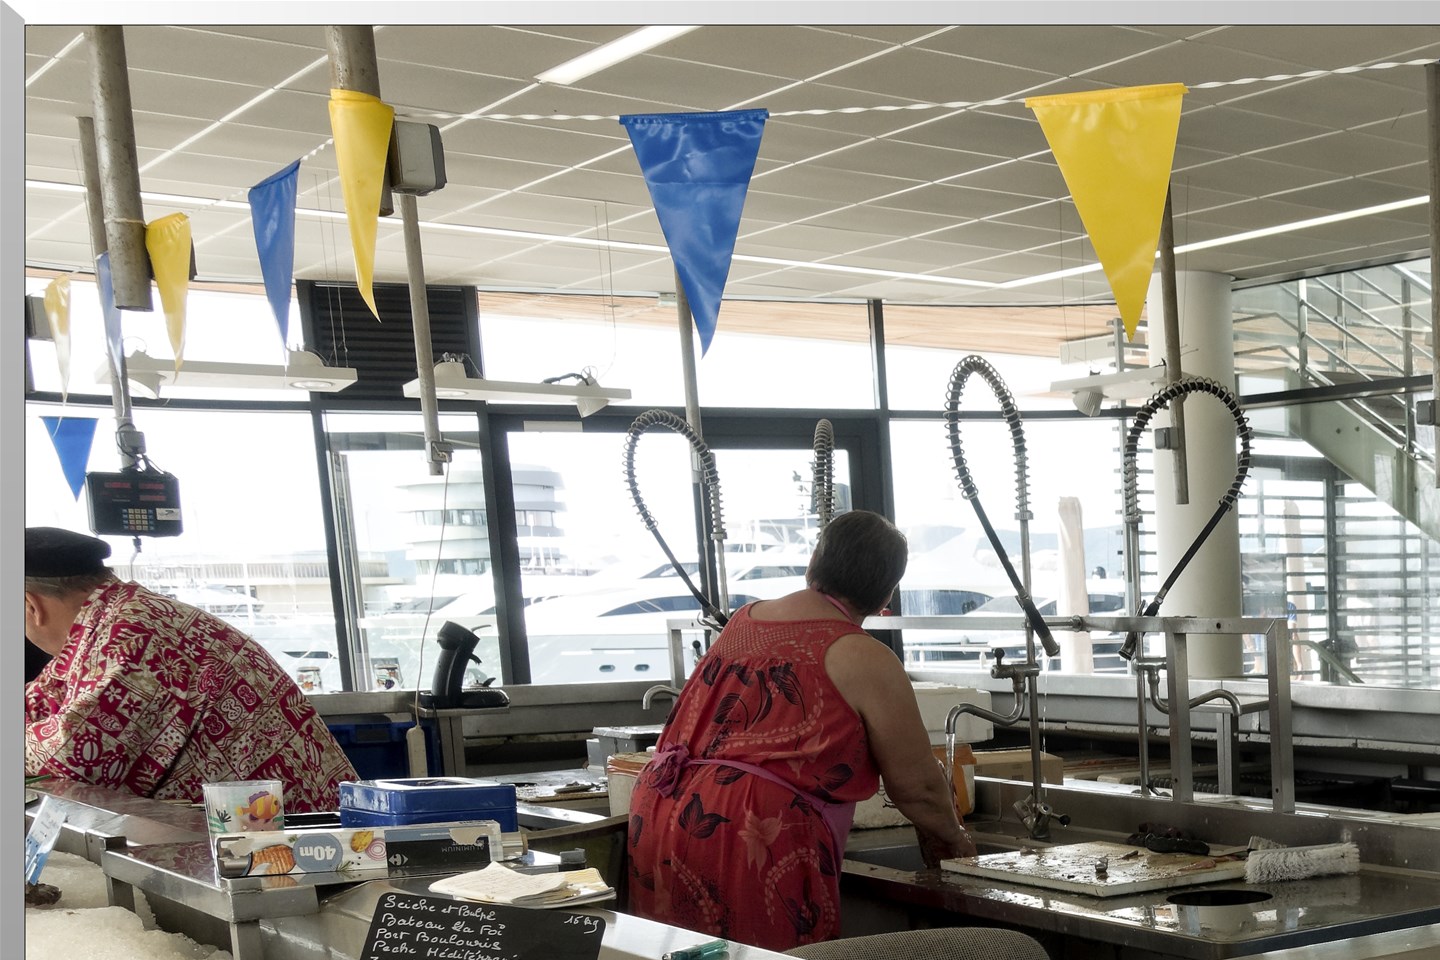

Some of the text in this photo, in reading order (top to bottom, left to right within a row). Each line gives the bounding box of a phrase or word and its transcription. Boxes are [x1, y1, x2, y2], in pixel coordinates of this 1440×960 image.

[299, 845, 337, 861] 40m
[382, 913, 446, 931] Bateau
[375, 928, 411, 940] Port
